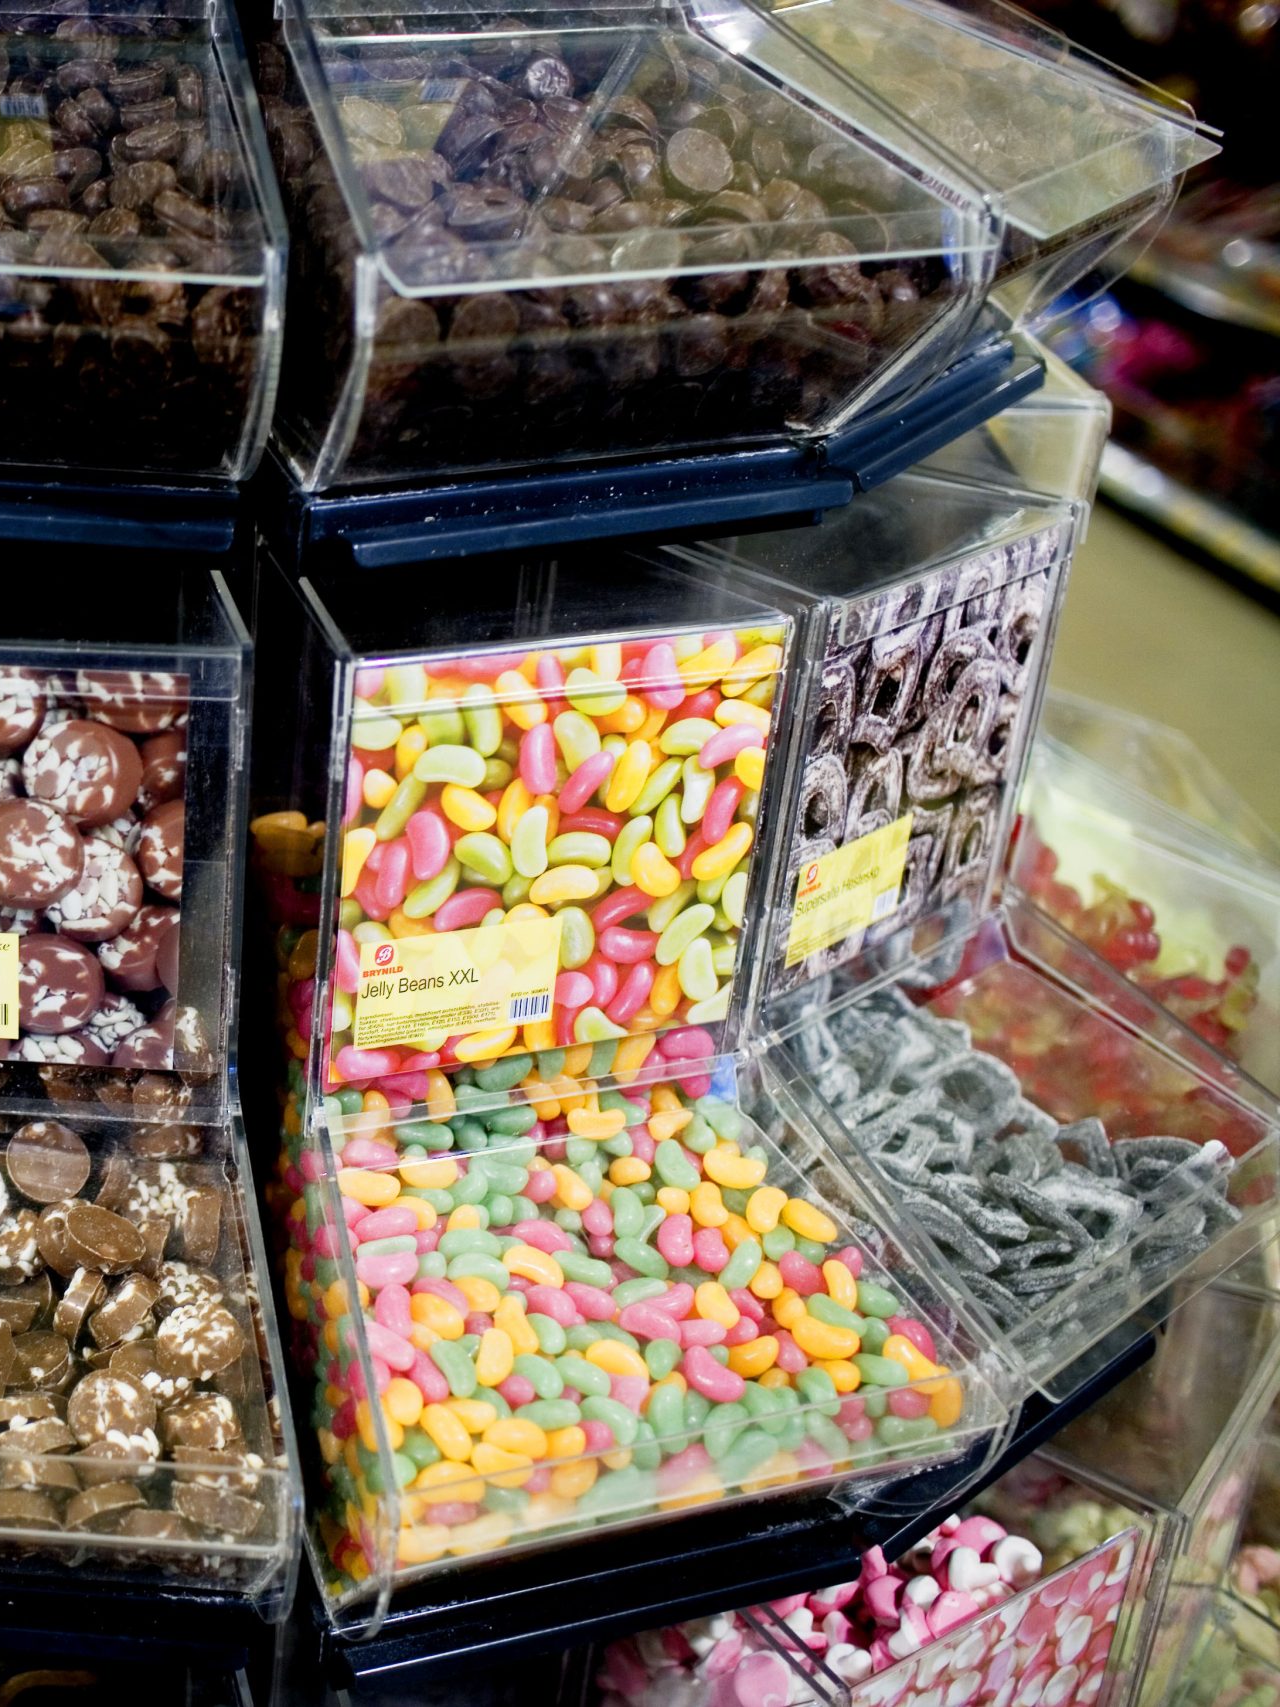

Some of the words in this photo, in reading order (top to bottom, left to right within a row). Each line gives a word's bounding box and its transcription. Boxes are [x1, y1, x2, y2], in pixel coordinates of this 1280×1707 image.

[362, 965, 404, 978] BRYNILD
[361, 981, 395, 999] Jelly
[398, 974, 445, 994] Beans
[449, 968, 479, 986] XXL
